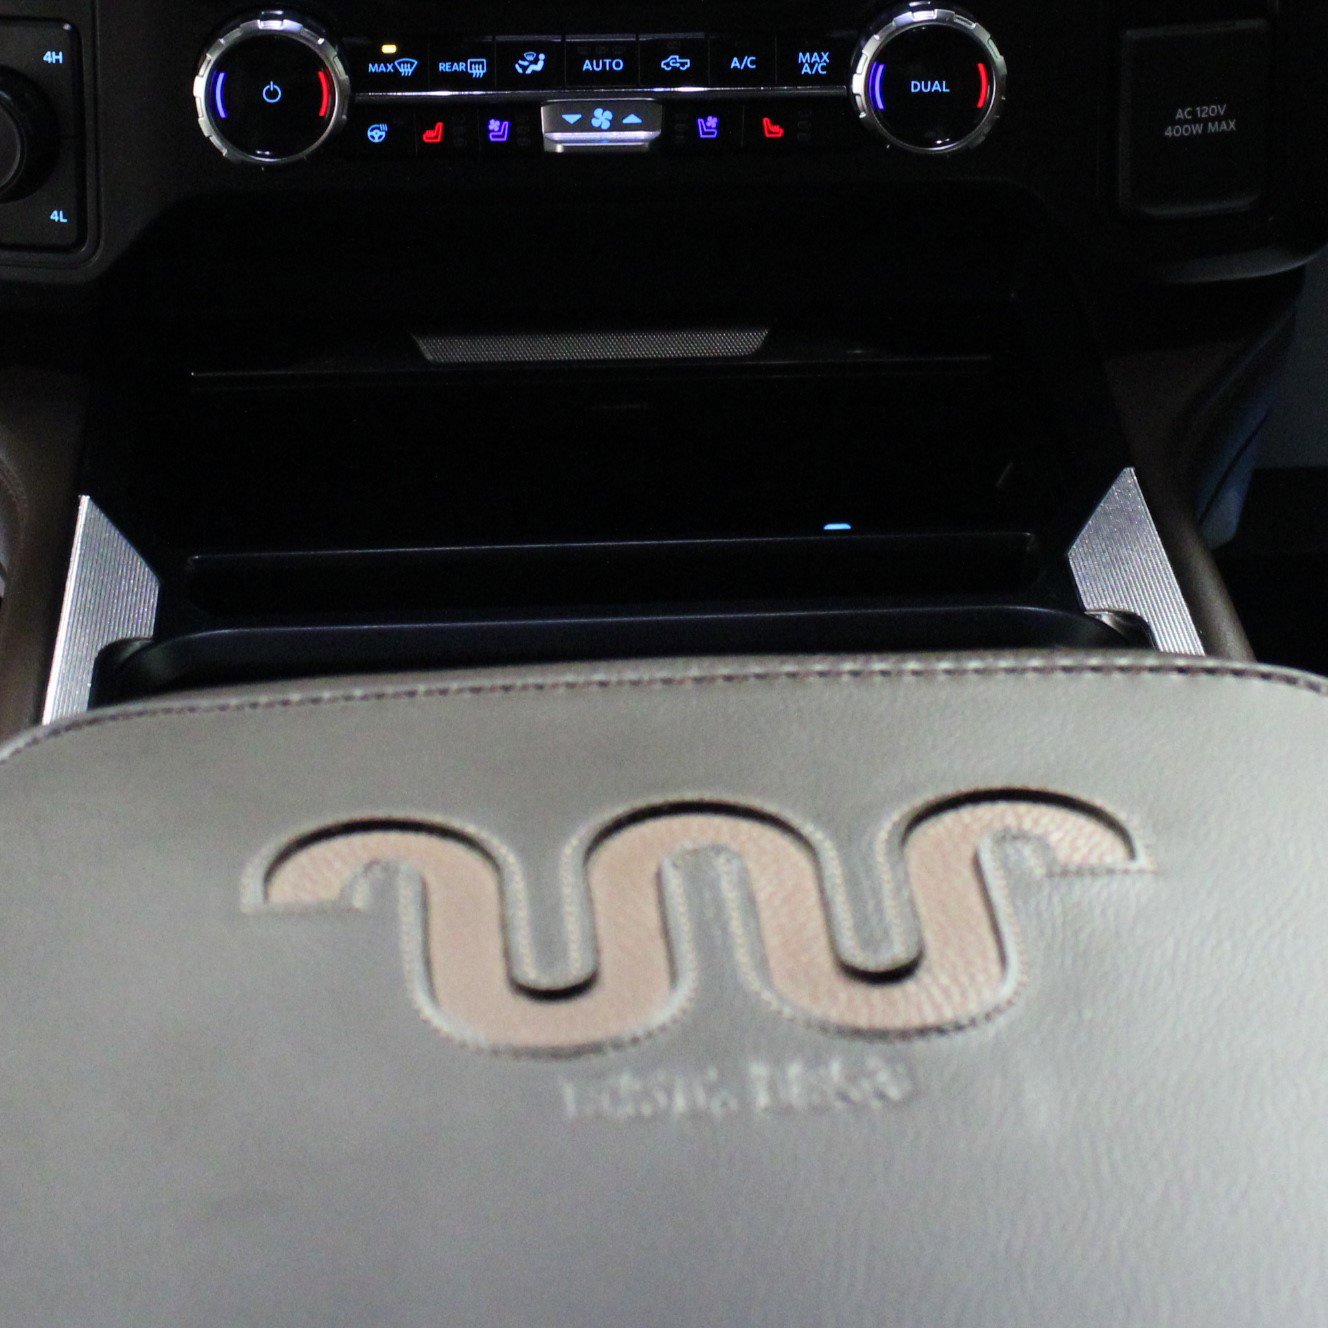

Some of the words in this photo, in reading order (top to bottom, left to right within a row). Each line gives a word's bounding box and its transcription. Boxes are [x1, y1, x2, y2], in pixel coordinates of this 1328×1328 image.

[42, 51, 64, 64] 4H
[730, 55, 757, 70] A/C
[798, 51, 830, 64] MAX
[368, 62, 394, 73] MAX
[438, 62, 467, 73] REAR
[582, 58, 623, 72] AUTO
[801, 62, 827, 76] A/C
[910, 80, 951, 93] DUAL
[1175, 107, 1193, 121] AC
[1195, 104, 1228, 119] 120V
[1164, 122, 1204, 139] 400W
[1207, 119, 1237, 135] MAX
[49, 210, 68, 223] 4L
